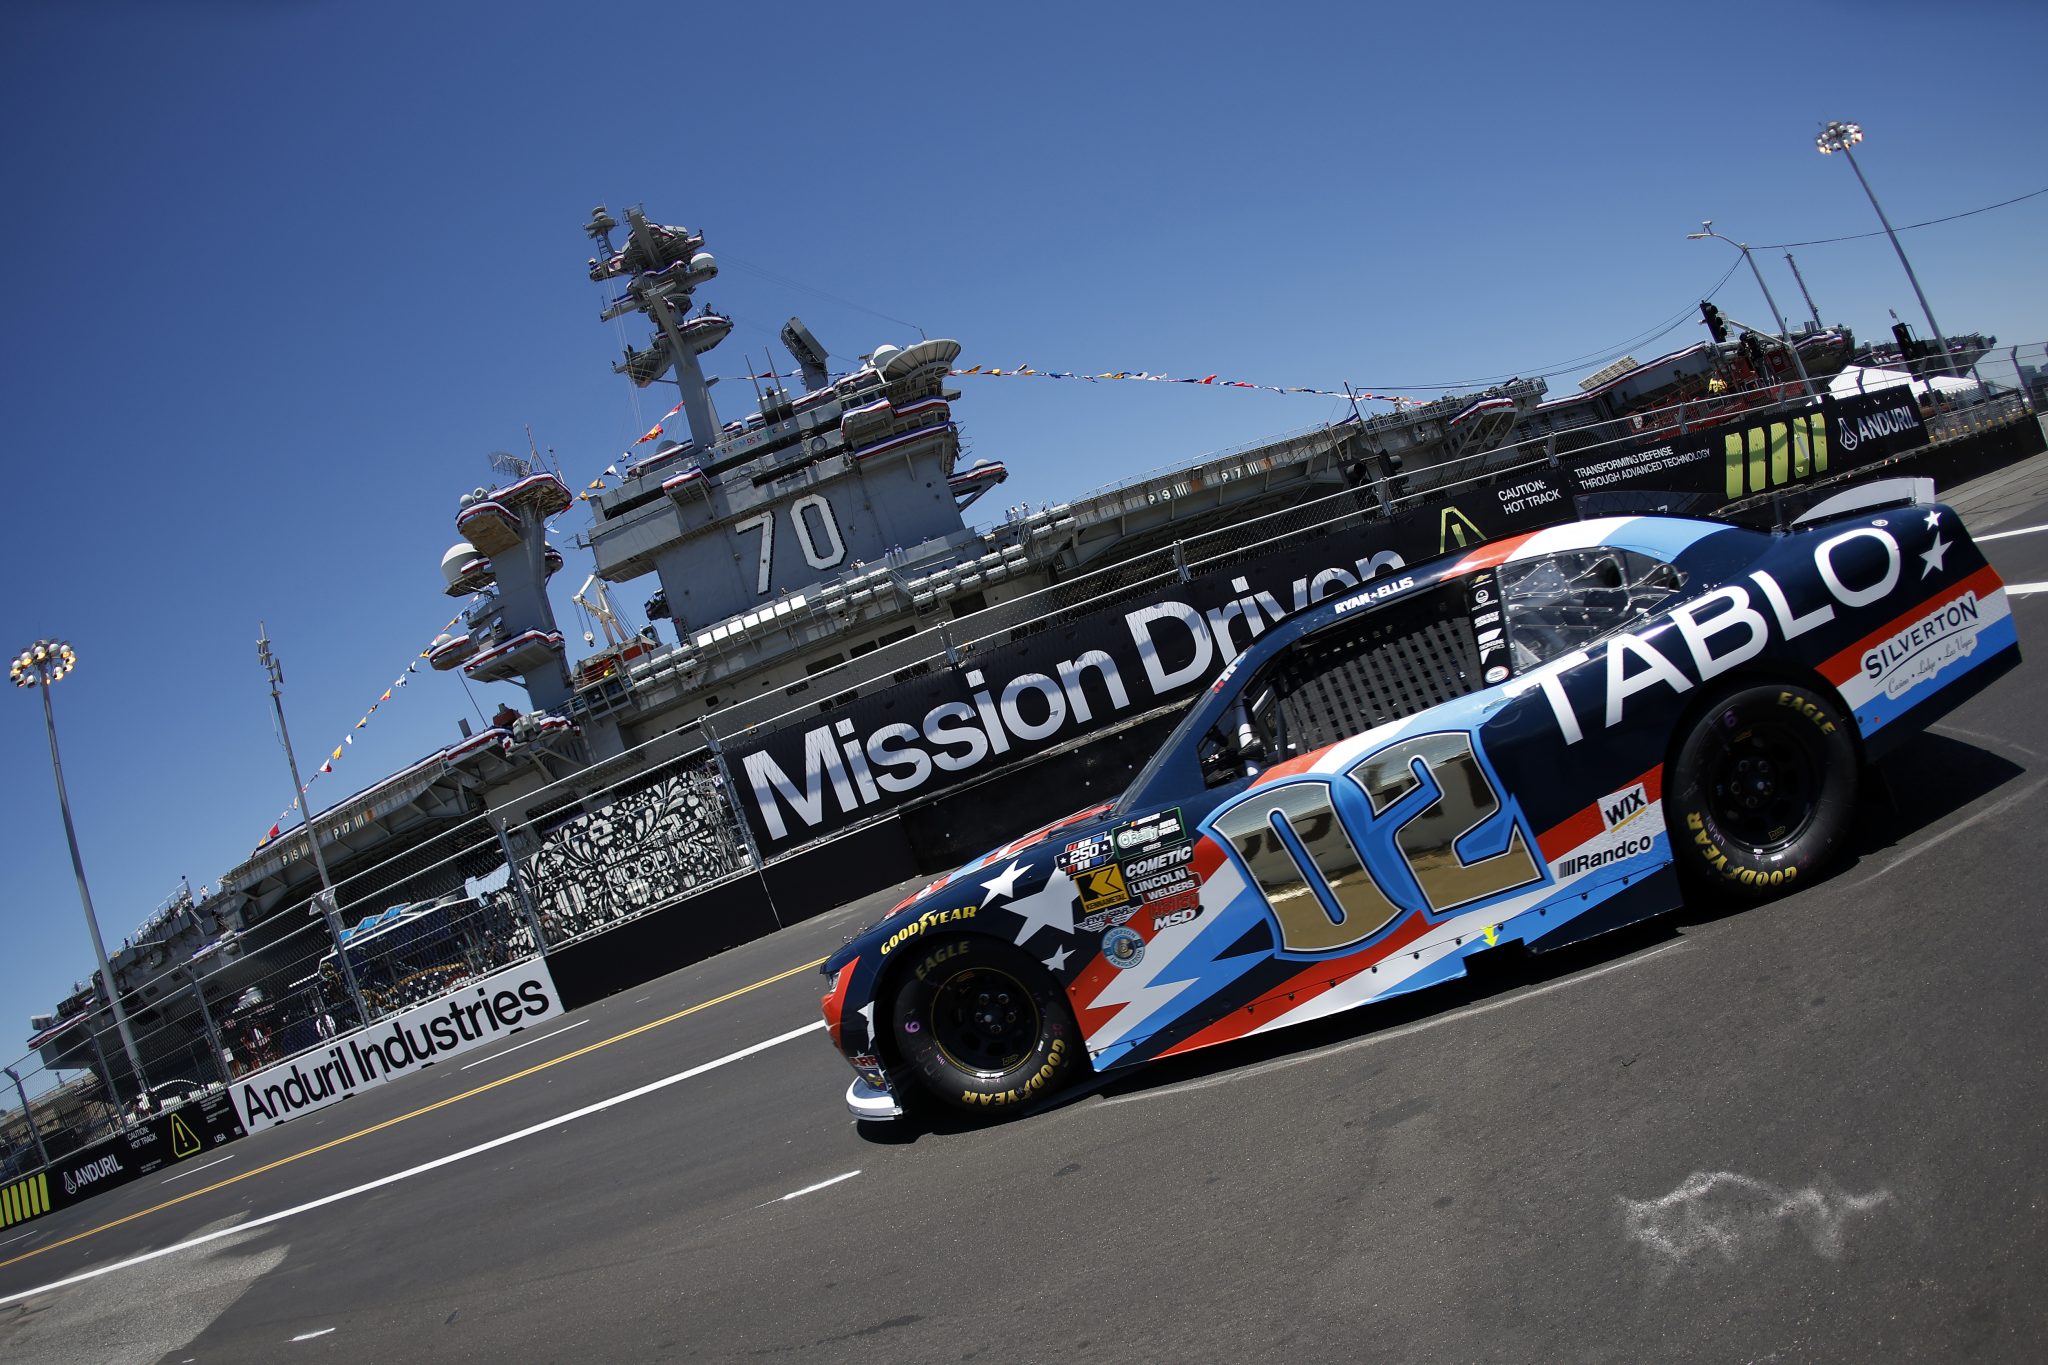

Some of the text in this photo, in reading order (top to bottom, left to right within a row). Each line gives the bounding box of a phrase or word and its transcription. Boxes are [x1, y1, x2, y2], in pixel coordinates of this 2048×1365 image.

[1859, 405, 1919, 443] ANDURIL
[1574, 446, 1674, 478] TRANSFORMING DEFENSE
[1579, 448, 1711, 490] THROUGH ADVANCED TECHNOLOGY
[1498, 479, 1547, 501] CAUTION:
[1503, 488, 1562, 515] HOT TRACK
[735, 493, 848, 596] 70
[1334, 576, 1415, 614] RYAN ELLIS
[1502, 527, 1901, 746] TABLO
[1865, 596, 1979, 680] SILVERTON
[1917, 658, 1936, 676] Lodge
[1778, 691, 1837, 736] EAGLE
[743, 649, 1130, 840] Mission
[1604, 787, 1646, 826] WIX
[1069, 843, 1100, 864] 250
[1125, 846, 1192, 878] COMETIC
[1142, 842, 1162, 852] SERIES
[1198, 729, 1554, 961] 02
[1577, 835, 1651, 873] Randco
[1687, 811, 1798, 887] GOODYEAR
[1131, 867, 1187, 894] LINCOLN
[1146, 880, 1196, 900] WELDERS
[880, 905, 977, 956] GOODYEAR
[1104, 927, 1138, 947] CHAMPION
[1153, 908, 1197, 931] MSD
[915, 940, 970, 981] EAGLE
[243, 978, 551, 1127] Anduril Industries
[961, 1039, 1066, 1107] GOODYEAR
[127, 1126, 149, 1141] CAUTION:
[130, 1132, 158, 1150] HOT TRACK
[213, 1132, 227, 1143] USA
[75, 1154, 123, 1188] ANDURIL
